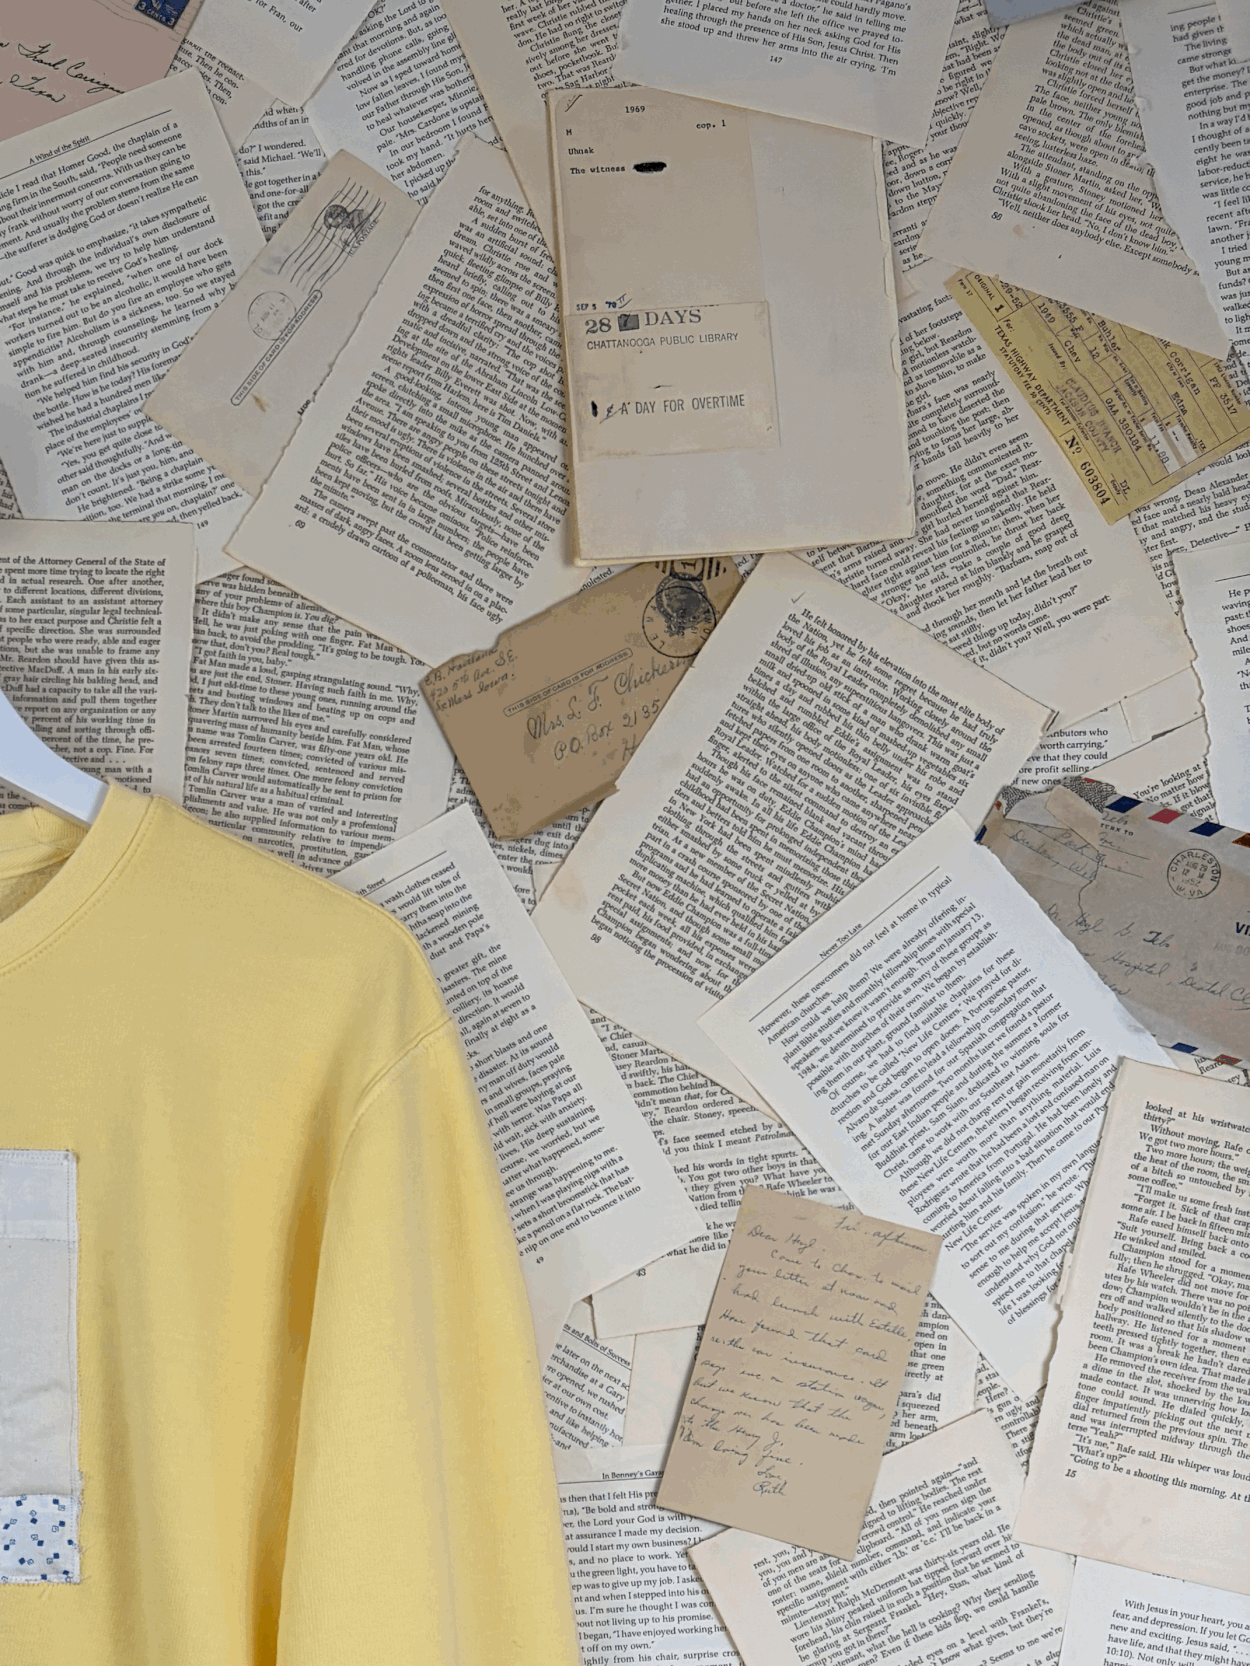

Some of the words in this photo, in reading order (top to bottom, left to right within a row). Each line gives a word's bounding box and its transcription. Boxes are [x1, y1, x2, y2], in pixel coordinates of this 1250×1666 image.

[660, 16, 676, 26] she
[677, 21, 701, 32] stood
[703, 26, 715, 37] up
[716, 29, 734, 38] and
[735, 32, 760, 43] threw
[762, 37, 777, 48] her
[778, 43, 799, 53] arms
[770, 55, 782, 64] 147
[625, 105, 646, 114] 1969
[695, 122, 716, 131] cop.
[29, 157, 36, 165] A
[34, 149, 54, 162] Wind
[53, 145, 61, 155] of
[61, 143, 72, 152] the
[72, 135, 91, 148] Spirit
[568, 146, 595, 156] Uhnak
[569, 167, 586, 175] The
[589, 165, 626, 174] witness
[585, 318, 612, 335] 28
[644, 309, 702, 327] DAYS
[586, 337, 656, 351] CHATTANOOGA
[659, 334, 695, 346] PUBLIC
[699, 332, 739, 343] LIBRARY
[1063, 338, 1081, 363] Chev
[994, 324, 1013, 348] TEXAS
[1010, 347, 1038, 382] HIGHWAY
[1034, 383, 1071, 426] DEPARTMENT
[1169, 351, 1201, 396] Corrigan
[634, 400, 656, 415] DAY
[663, 398, 685, 413] FOR
[691, 393, 746, 411] OVERTIME
[1080, 461, 1111, 506] 603804
[196, 520, 208, 529] 149
[12, 555, 22, 564] of
[23, 555, 37, 565] the
[37, 556, 74, 568] Attorney
[74, 556, 107, 566] General
[507, 702, 525, 714] THIS
[524, 693, 542, 706] SIDE
[542, 688, 552, 697] OF
[551, 679, 572, 692] CARD
[571, 674, 580, 682] IS
[579, 667, 595, 678] FOR
[595, 651, 629, 671] ADDRESS
[1171, 850, 1221, 884] CHARLESTON
[818, 942, 839, 960] Never
[835, 934, 850, 945] Too
[847, 923, 863, 936] Late
[535, 1256, 544, 1265] 49
[636, 1268, 647, 1277] 43
[602, 1471, 610, 1480] In
[611, 1470, 644, 1480] Bonney's
[1065, 1469, 1076, 1478] 15
